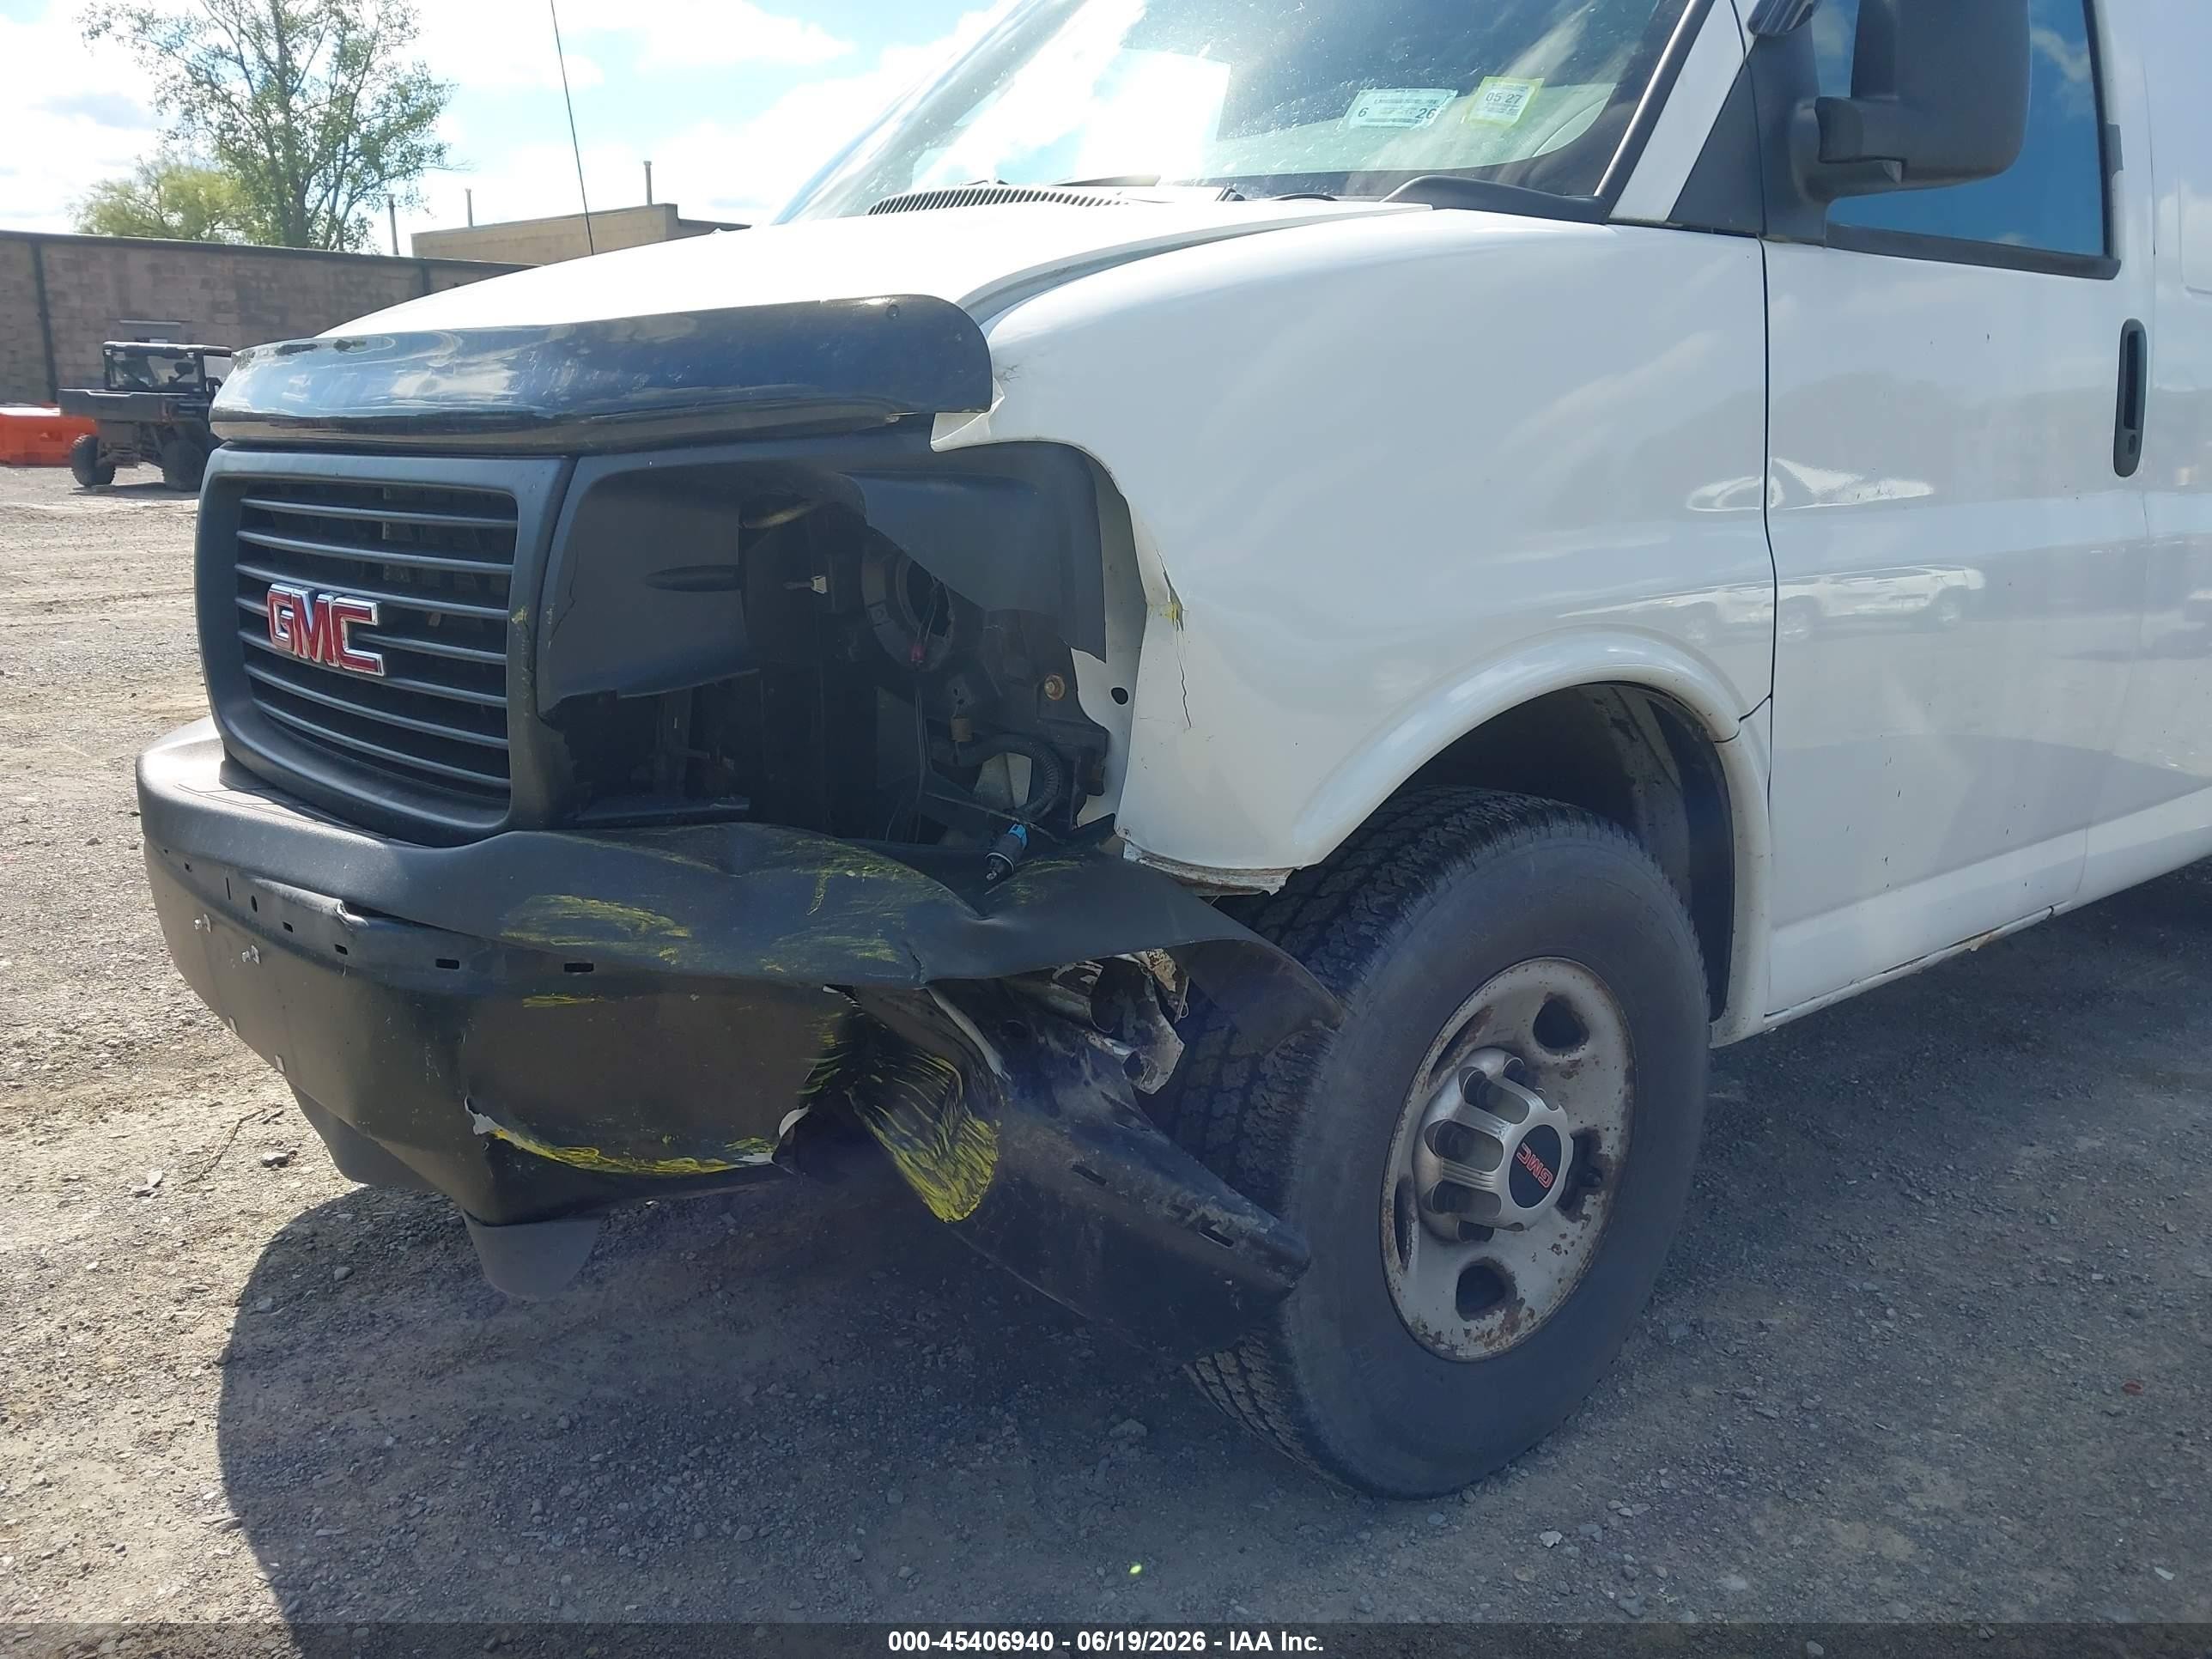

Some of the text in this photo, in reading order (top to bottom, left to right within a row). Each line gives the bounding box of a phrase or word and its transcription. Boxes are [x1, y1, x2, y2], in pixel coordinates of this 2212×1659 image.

[1486, 92, 1522, 104] 05 27
[1358, 107, 1369, 118] 6
[1415, 107, 1437, 119] 26
[267, 583, 385, 677] GMC
[1517, 1143, 1553, 1188] GMC
